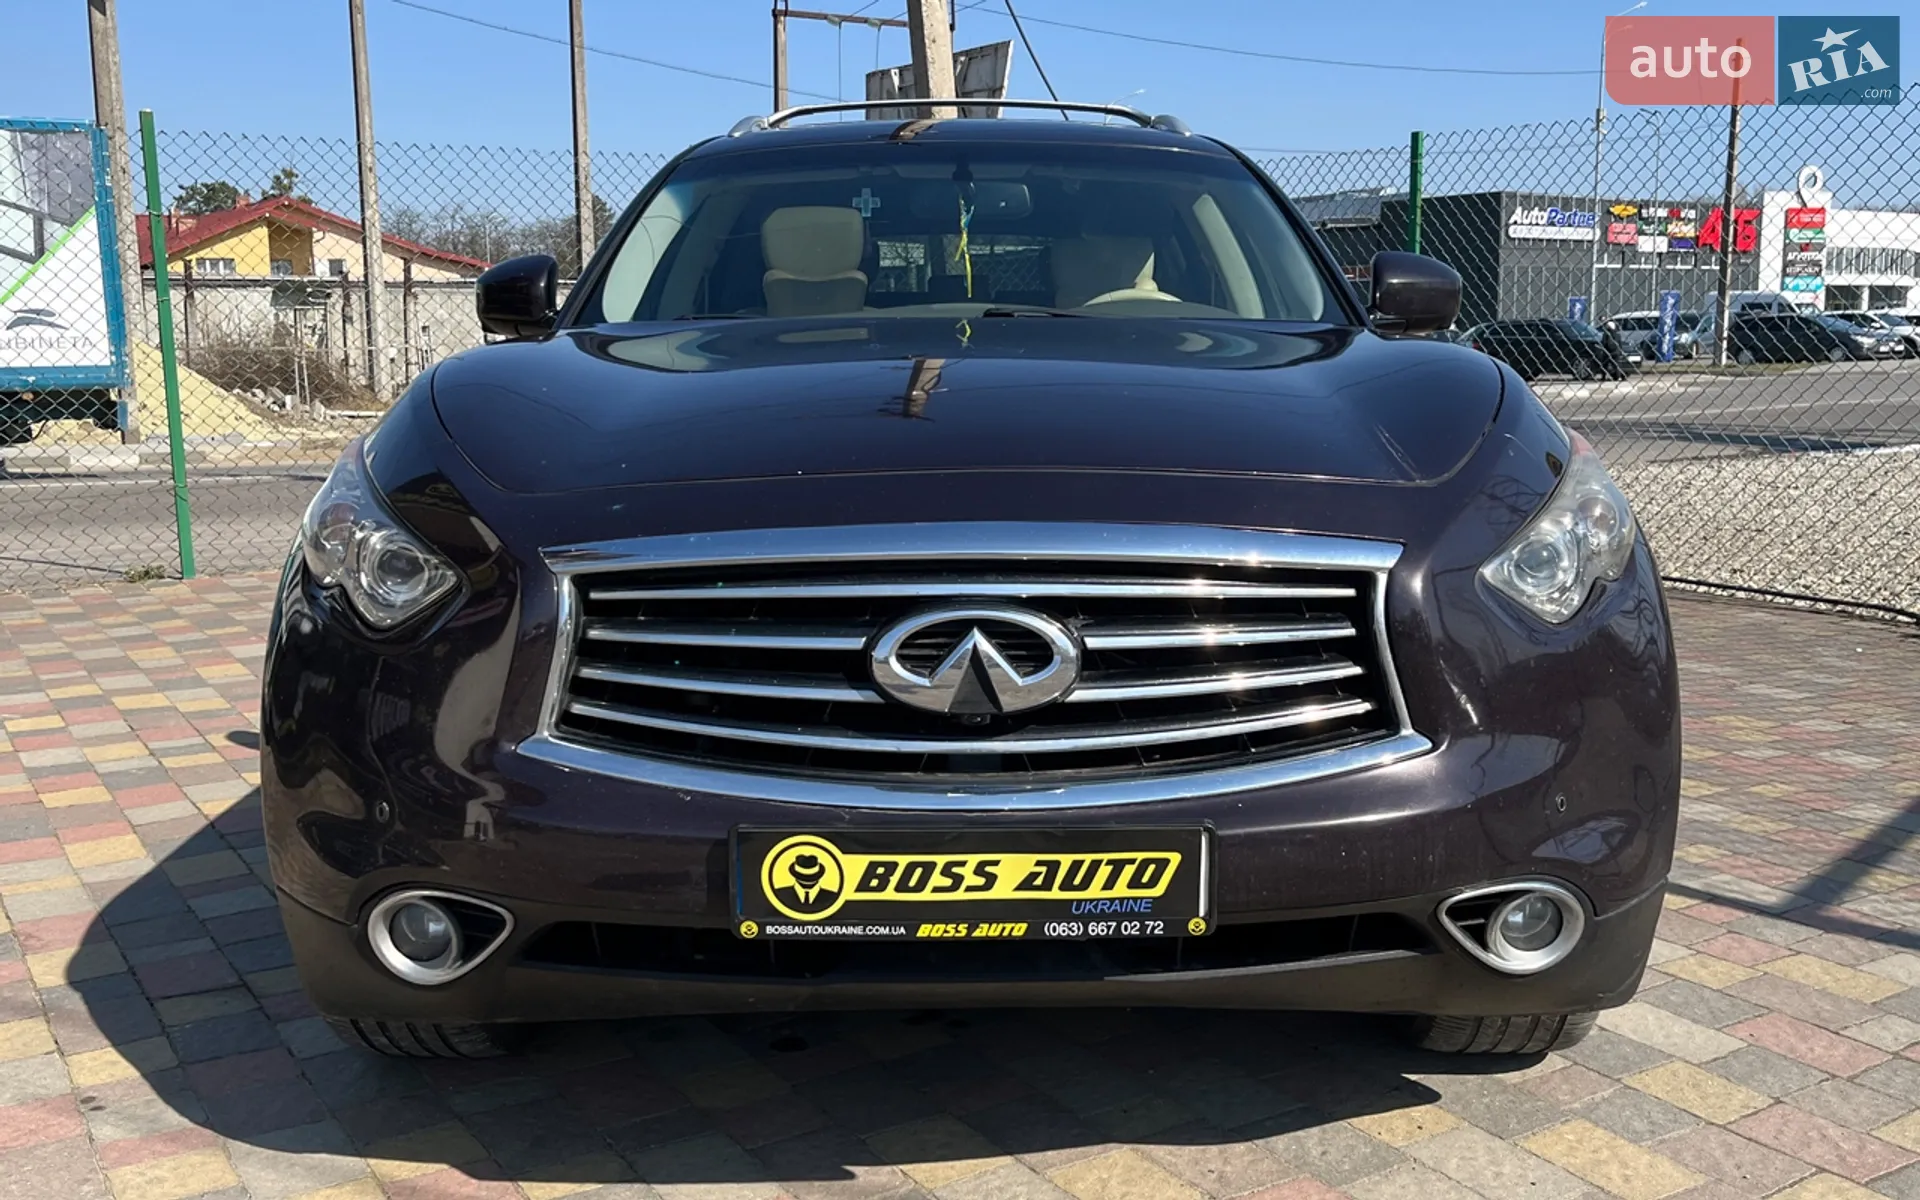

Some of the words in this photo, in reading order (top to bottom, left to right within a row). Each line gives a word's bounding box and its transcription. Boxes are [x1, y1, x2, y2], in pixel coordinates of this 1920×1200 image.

[1508, 206, 1598, 227] AutoPartne
[854, 859, 1001, 893] BOSS
[1012, 857, 1171, 892] AUTO
[1071, 898, 1153, 914] UKRAINE
[765, 925, 906, 936] BOSSAUTOUKRAINE.COM.UA
[916, 923, 968, 938] BOSS
[971, 923, 1028, 937] AUTO
[1044, 921, 1084, 937] (063)
[1088, 921, 1117, 936] 667
[1121, 921, 1140, 935] 02
[1144, 921, 1164, 935] 72
